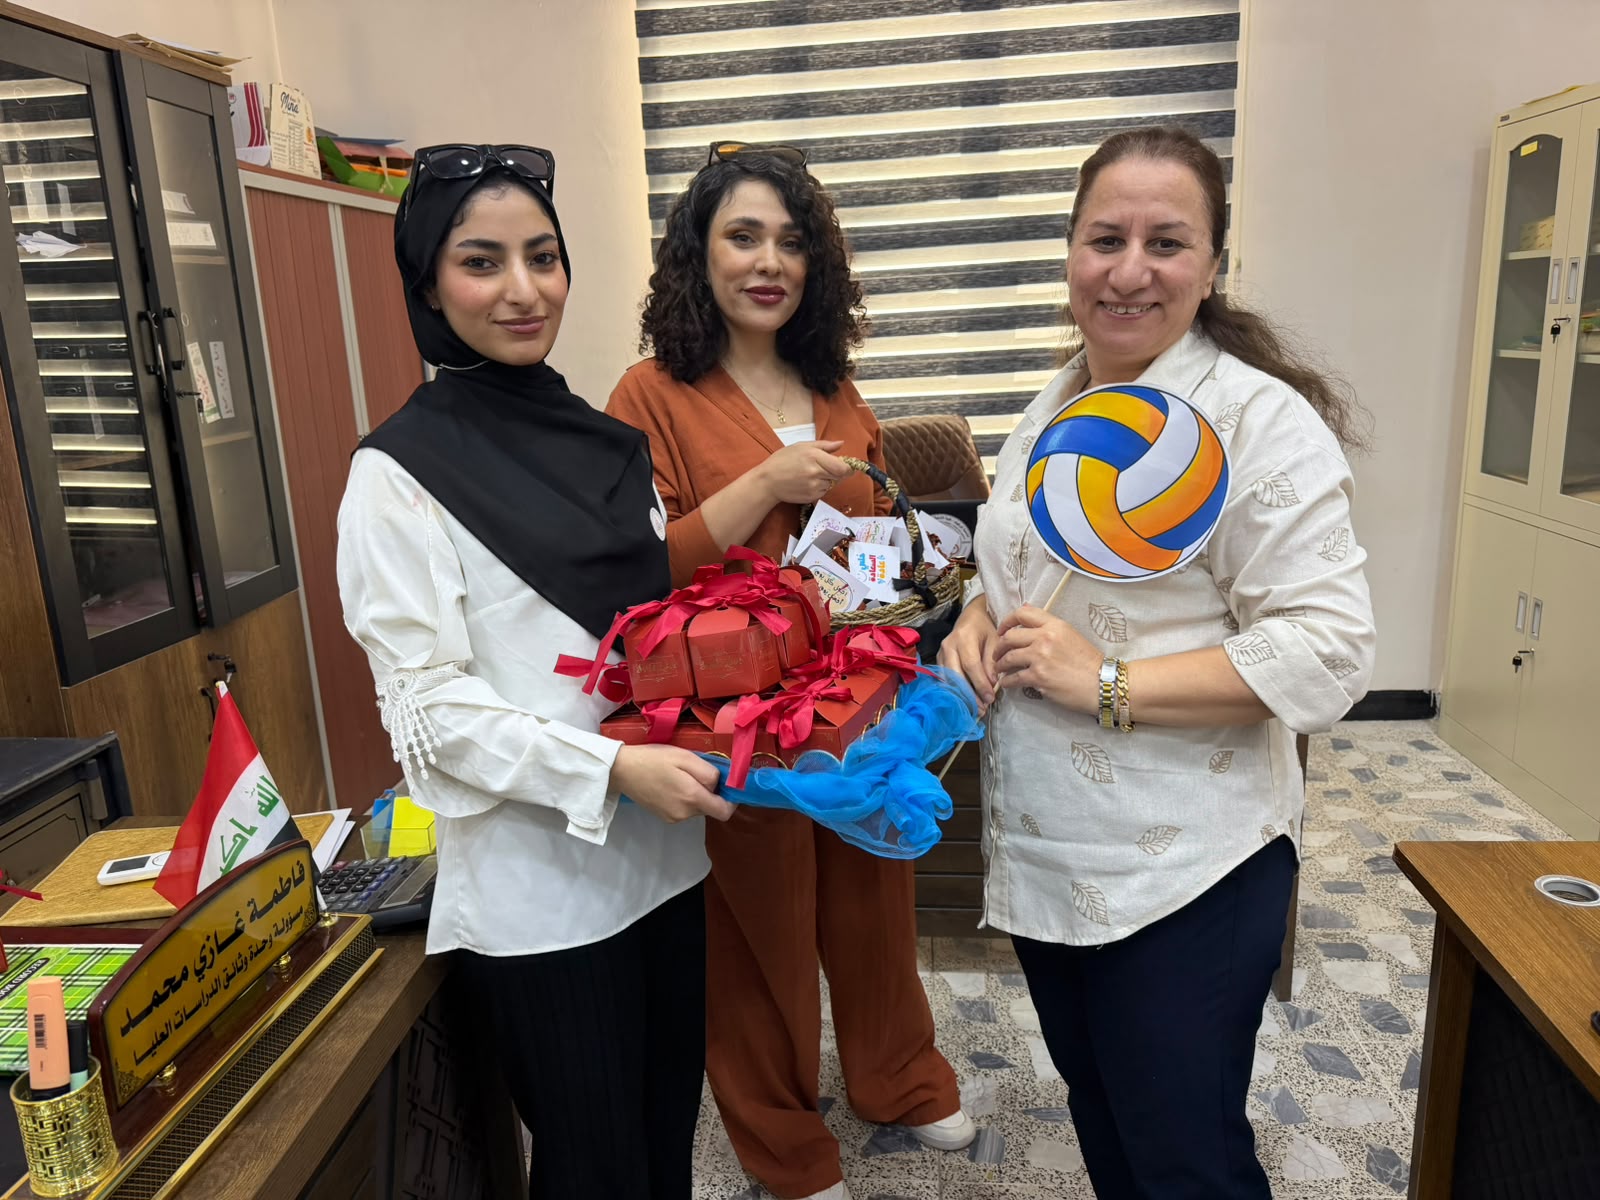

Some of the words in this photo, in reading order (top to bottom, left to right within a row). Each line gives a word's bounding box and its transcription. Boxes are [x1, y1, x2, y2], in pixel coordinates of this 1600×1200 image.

[247, 860, 306, 923] فاطمة
[193, 912, 247, 982] غازي
[249, 932, 273, 962] وحدة
[274, 905, 304, 938] مسؤولة
[221, 954, 248, 987] وثائق
[121, 963, 189, 1038] محمد
[175, 975, 221, 1029] الدراسات
[133, 1014, 173, 1067] العليا
